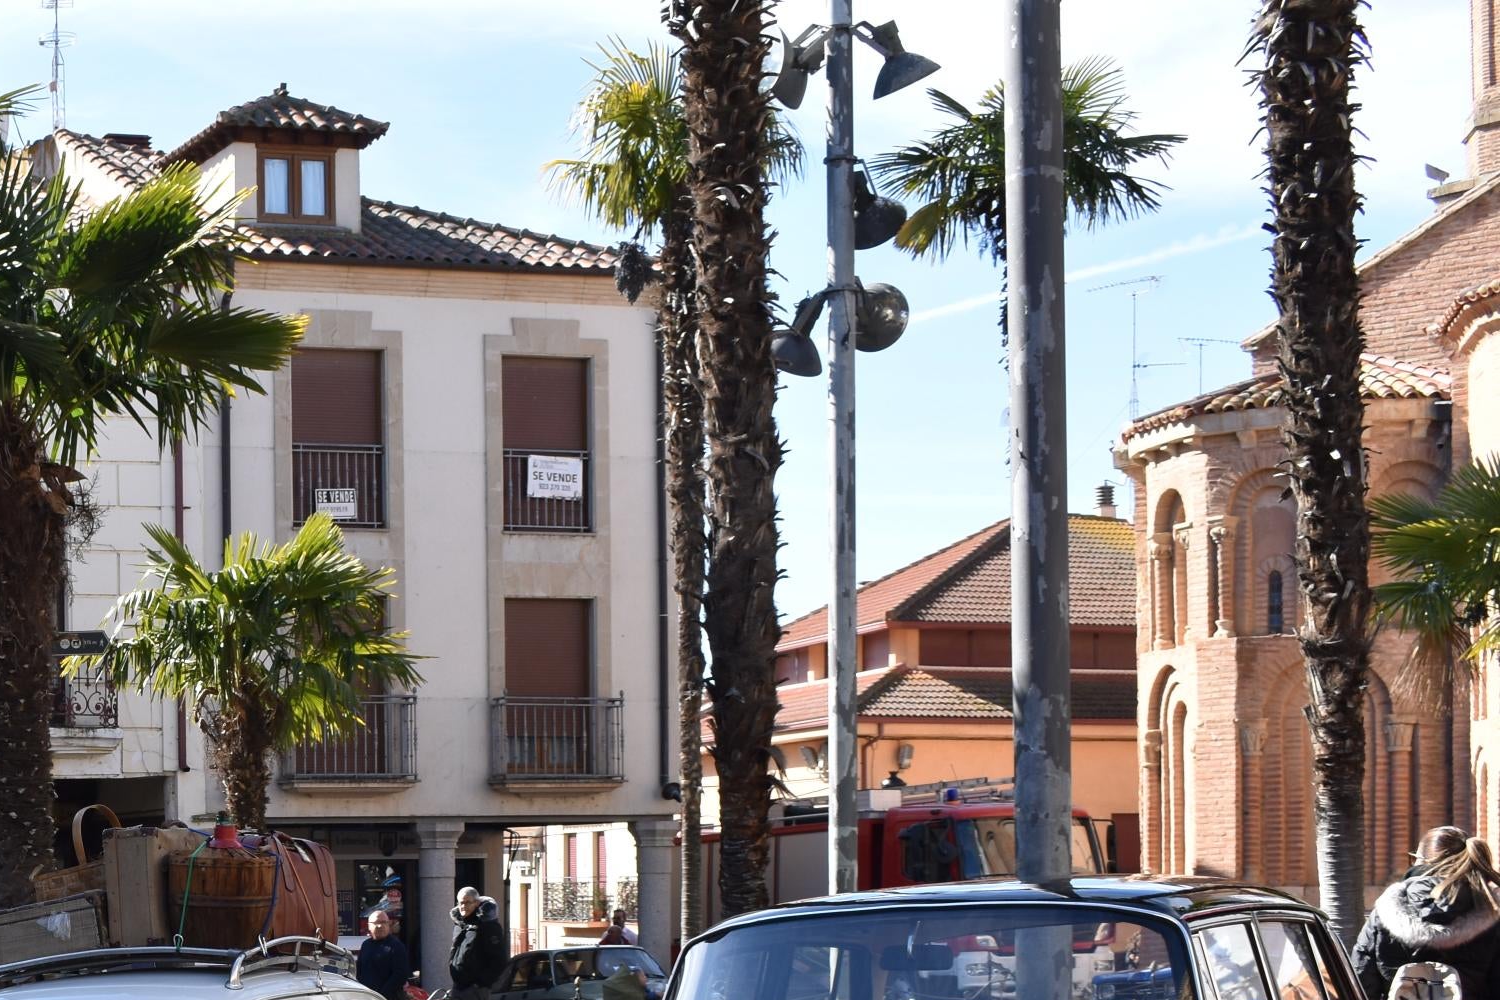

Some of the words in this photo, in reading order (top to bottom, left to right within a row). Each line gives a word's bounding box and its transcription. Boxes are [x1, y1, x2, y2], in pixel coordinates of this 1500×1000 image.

[533, 471, 544, 480] SE
[547, 472, 578, 483] VENDE
[318, 491, 328, 502] SE
[329, 491, 354, 502] VENDE
